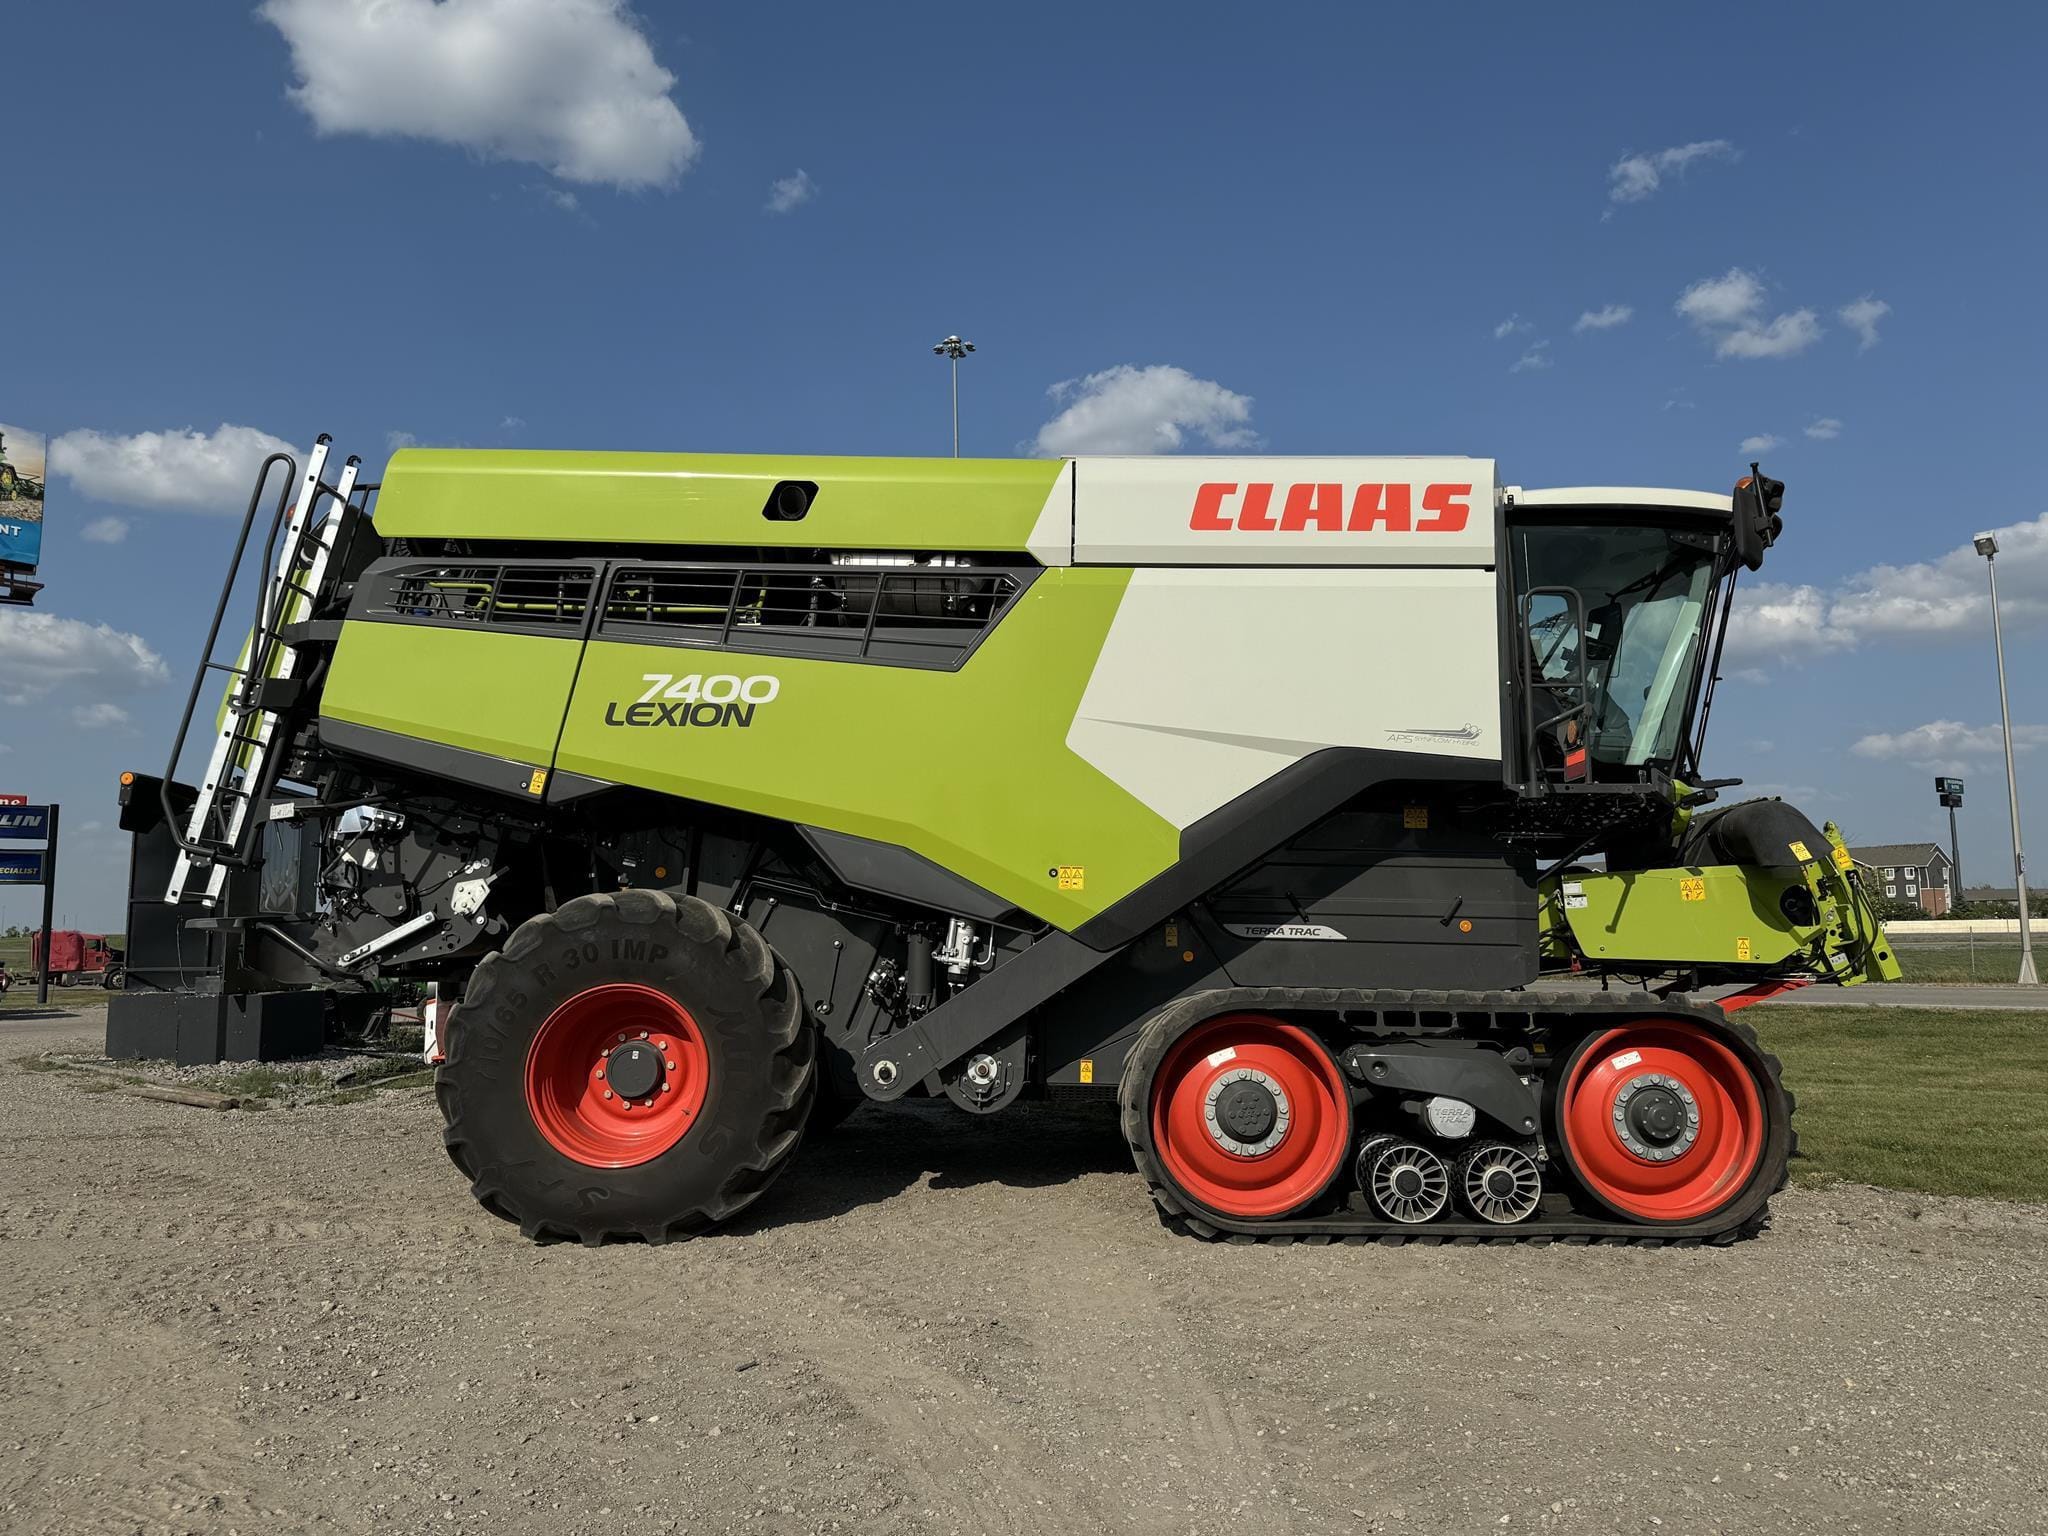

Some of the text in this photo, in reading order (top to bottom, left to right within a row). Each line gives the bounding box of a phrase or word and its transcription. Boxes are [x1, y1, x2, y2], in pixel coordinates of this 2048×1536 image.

[1189, 482, 1473, 532] CLAAS
[636, 673, 781, 705] 7400
[604, 702, 757, 728] LEXION
[1385, 733, 1414, 744] APS
[1244, 926, 1322, 937] TERRA TRAC
[561, 944, 600, 970] 30
[610, 938, 671, 965] IMP
[1434, 1107, 1471, 1116] TERRA
[1439, 1115, 1469, 1124] TRAC
